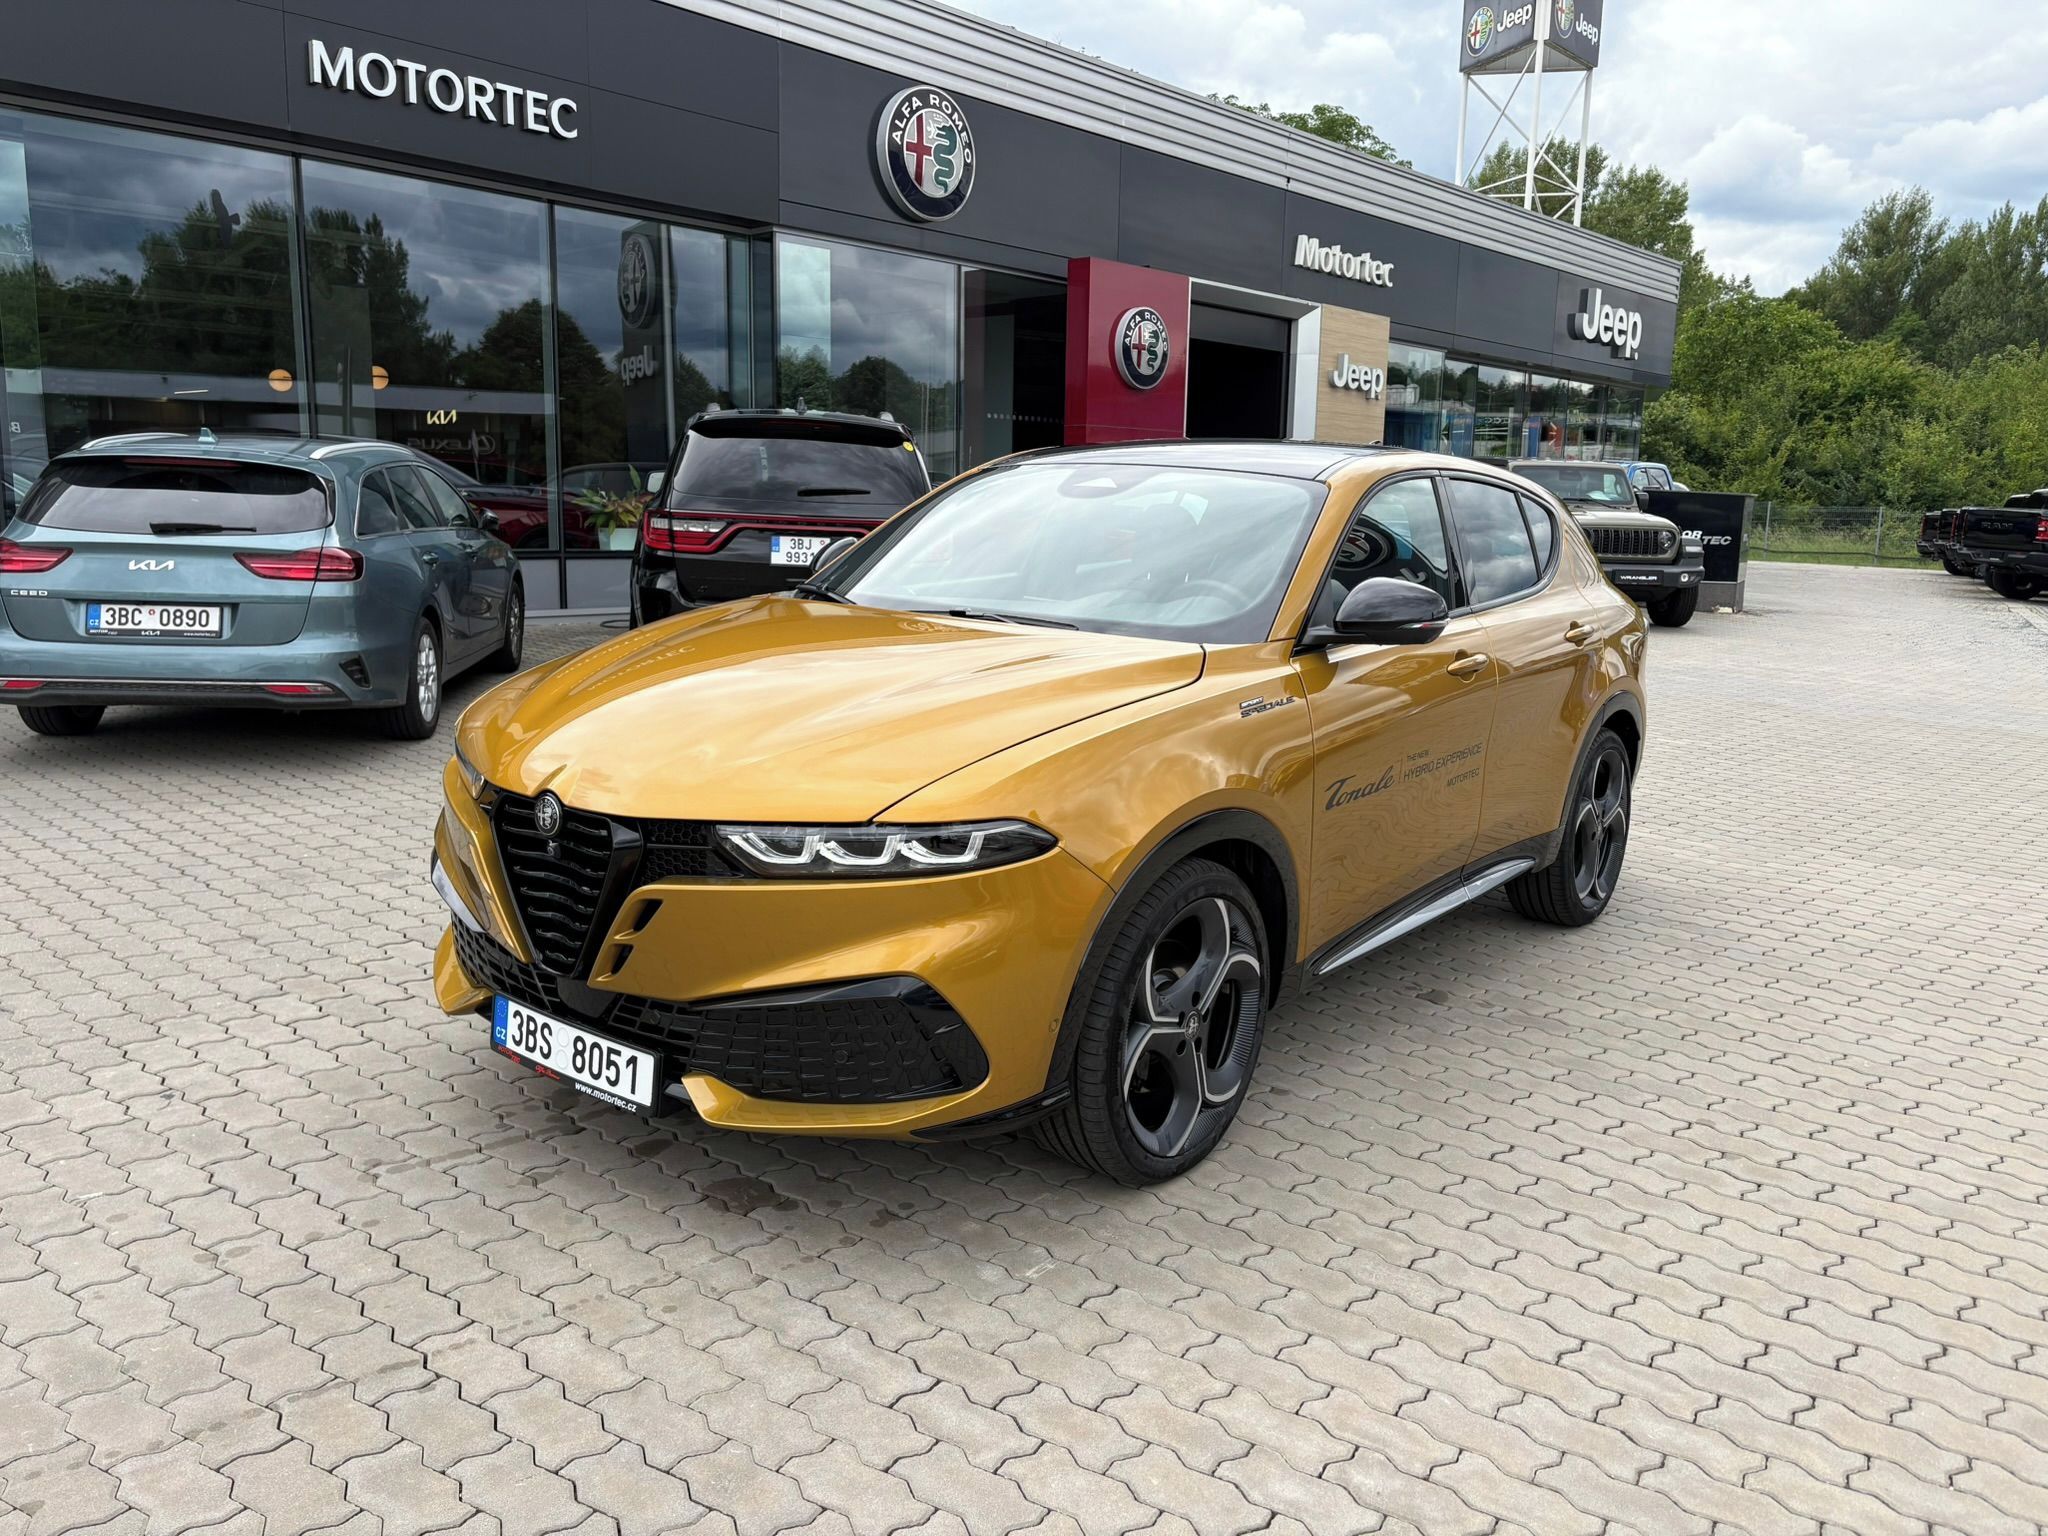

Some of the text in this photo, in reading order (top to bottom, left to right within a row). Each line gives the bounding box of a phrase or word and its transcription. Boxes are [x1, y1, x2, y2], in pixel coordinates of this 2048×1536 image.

[1497, 3, 1533, 32] Jeep
[1575, 13, 1599, 45] Jeep
[308, 39, 578, 139] MOTORTEC
[892, 93, 972, 163] ALFA ROMEO
[1294, 234, 1394, 287] Motortec
[1124, 311, 1168, 351] ALFA ROMEO
[1580, 288, 1642, 360] Jeep
[1331, 353, 1384, 399] Jeep
[426, 409, 457, 425] KIA
[789, 538, 812, 550] 3BJ
[1701, 536, 1732, 545] TEC
[128, 559, 175, 571] KIA
[89, 618, 99, 627] CZ
[105, 607, 210, 628] 3BC 0890
[1240, 696, 1296, 718] SPECIALE
[1403, 742, 1483, 782] HYBRID EXPERIENCE
[1446, 767, 1480, 788] MOTORTEC
[1324, 764, 1395, 811] Tonale
[495, 1026, 506, 1041] CZ
[511, 1009, 638, 1095] 3BS 8051
[575, 1081, 637, 1113] www.motortec.cz
